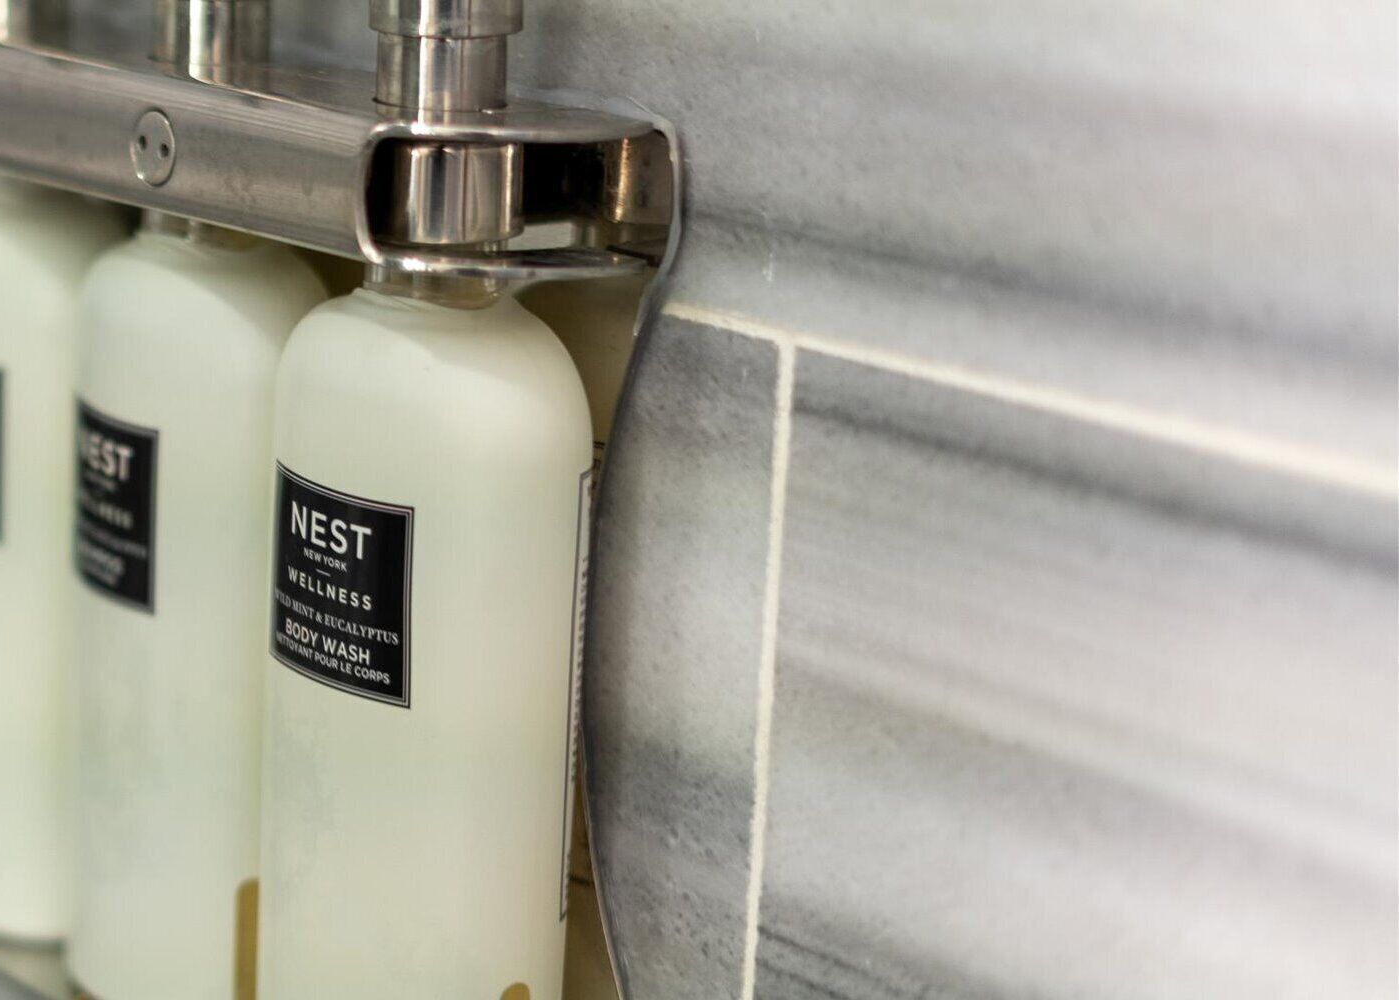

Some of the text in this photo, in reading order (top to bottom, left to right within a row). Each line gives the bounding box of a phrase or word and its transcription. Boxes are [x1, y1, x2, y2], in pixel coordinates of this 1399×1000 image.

[291, 500, 371, 560] NEST
[303, 546, 347, 572] NEW YORK
[287, 565, 372, 611] WELLNESS
[285, 617, 370, 666] BODY WASH
[292, 599, 314, 619] MINT
[315, 611, 322, 624] &
[324, 613, 399, 645] EUCALYPTUS
[314, 650, 338, 670] POUR
[340, 660, 352, 675] LE
[354, 665, 390, 685] CORPS
